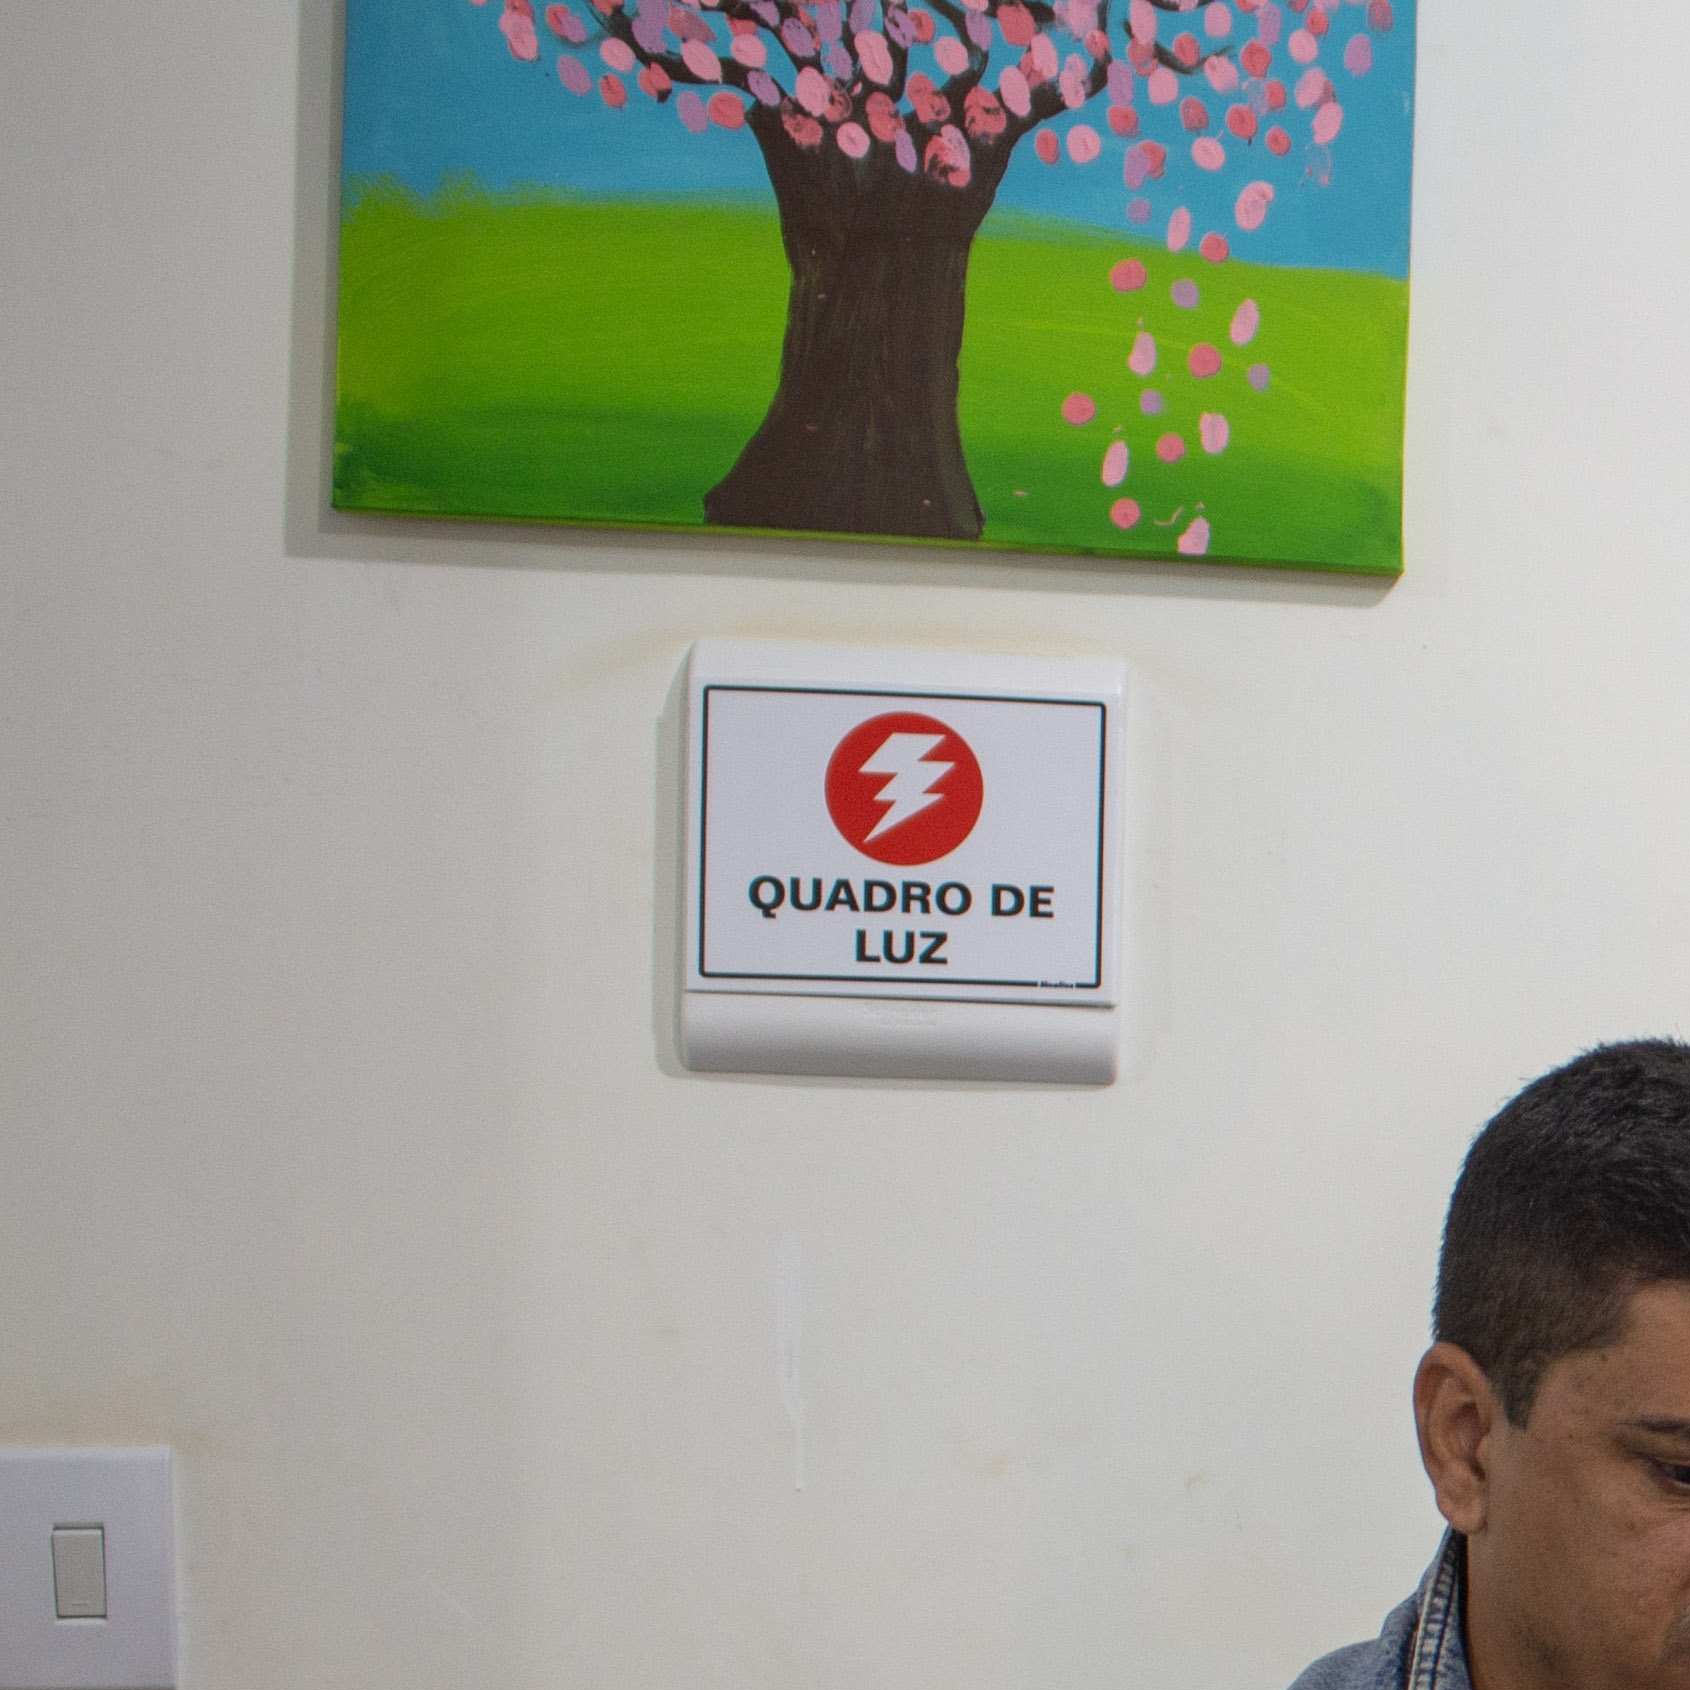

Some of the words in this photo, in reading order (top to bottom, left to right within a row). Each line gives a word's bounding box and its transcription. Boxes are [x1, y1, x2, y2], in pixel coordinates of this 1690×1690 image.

[748, 875, 973, 918] QUADRO
[990, 884, 1055, 918] DE
[854, 929, 949, 965] LUZ
